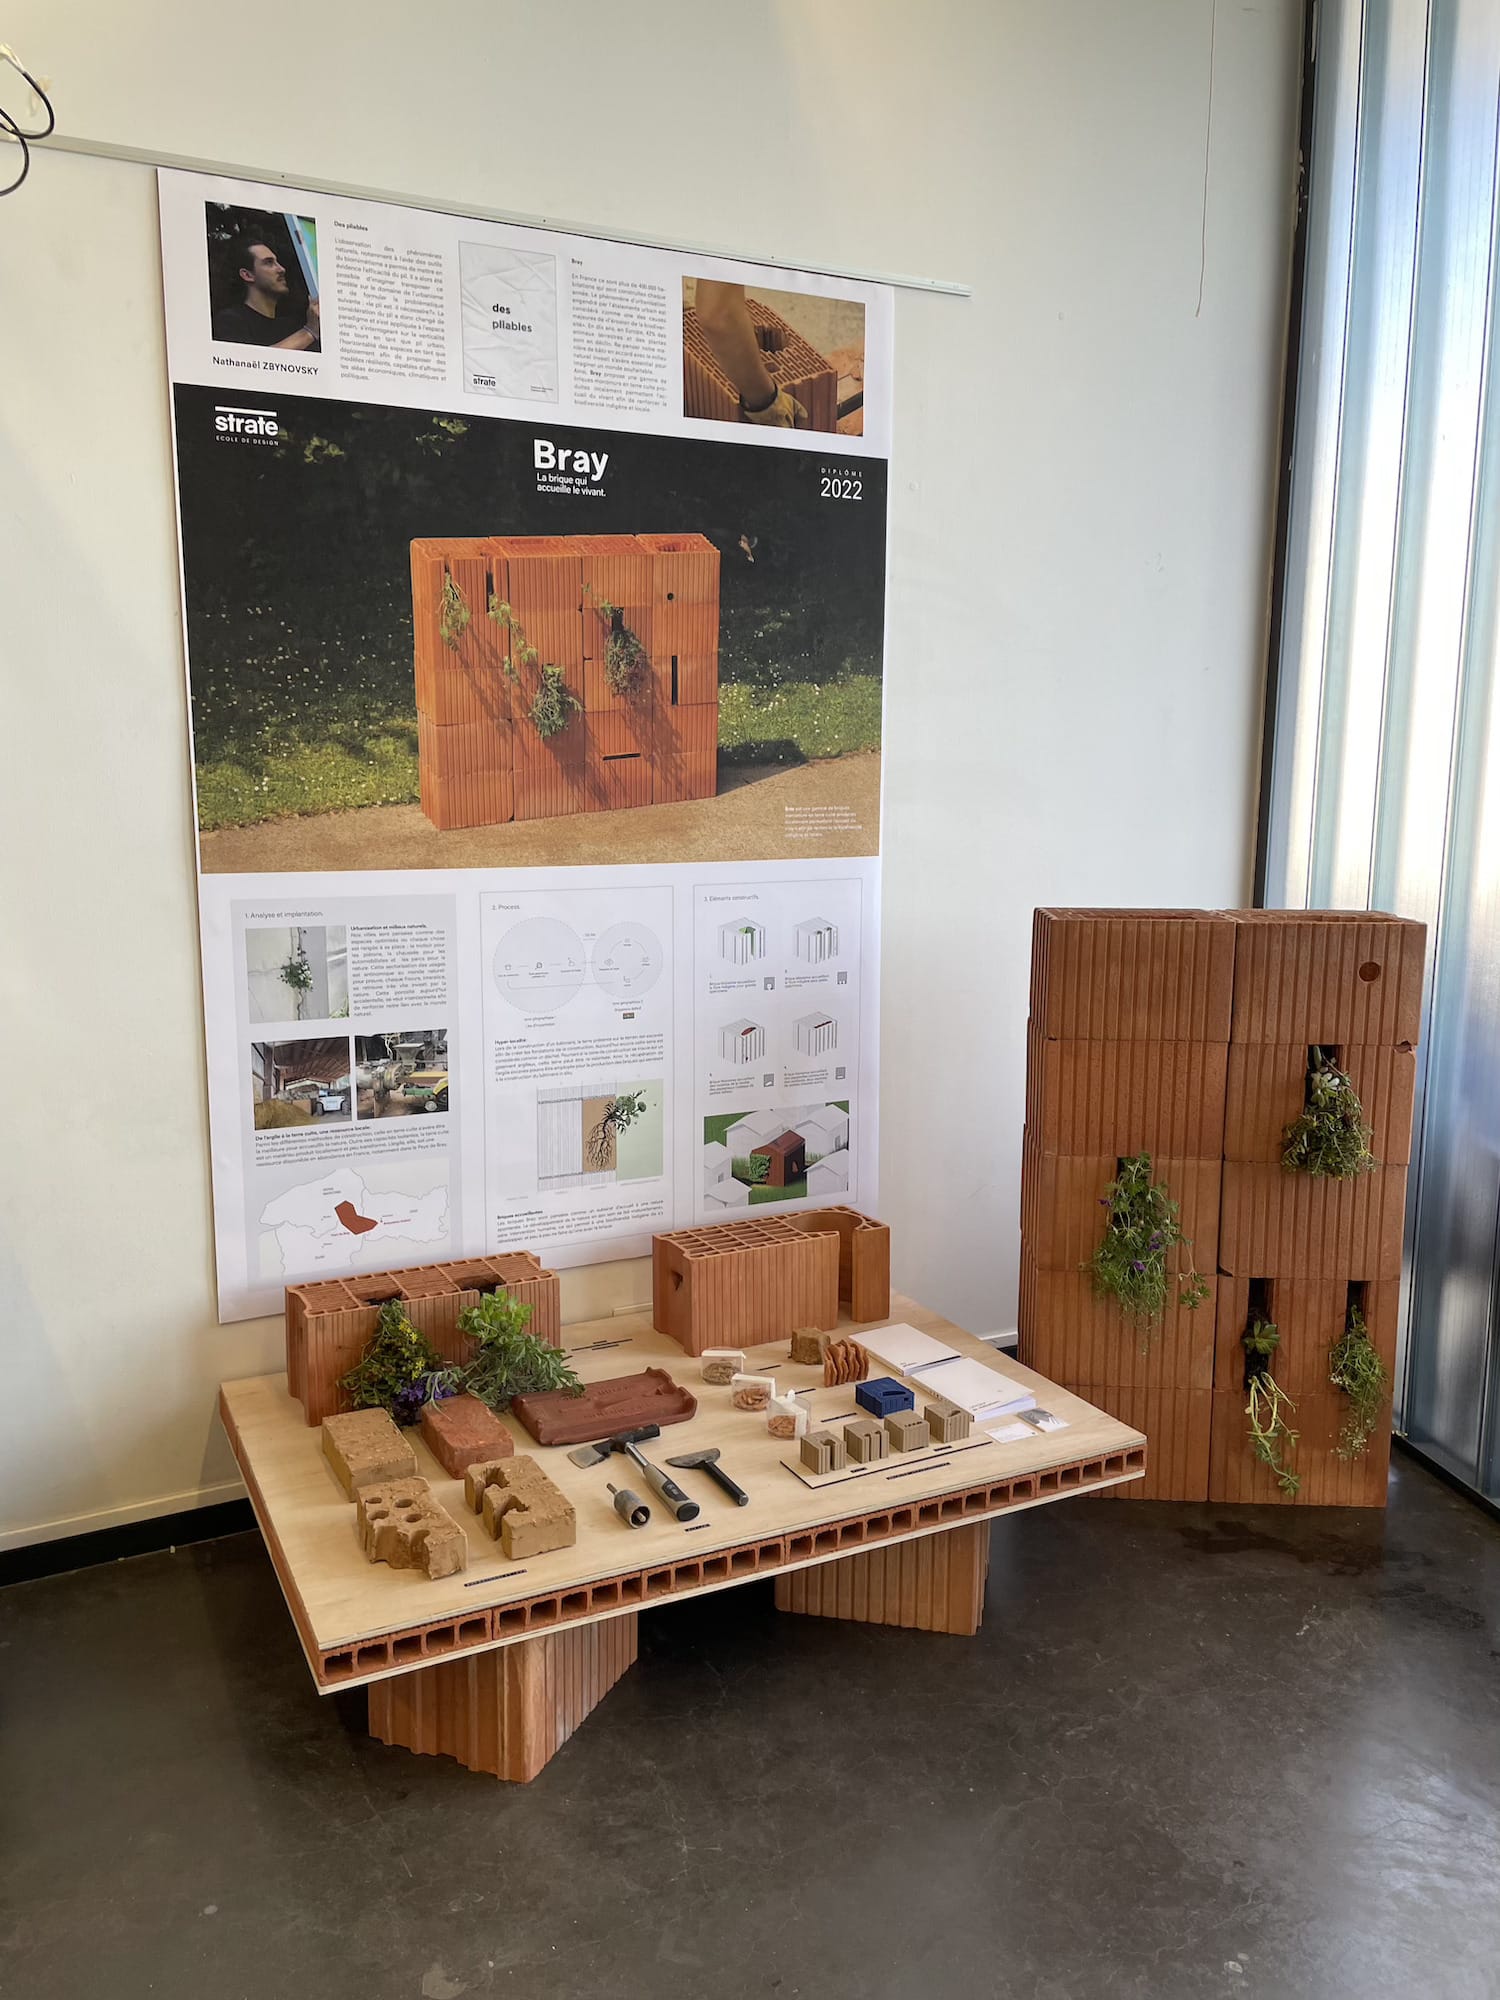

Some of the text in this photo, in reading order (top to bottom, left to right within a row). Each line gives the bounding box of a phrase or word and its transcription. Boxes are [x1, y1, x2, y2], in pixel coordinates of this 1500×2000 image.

[346, 223, 368, 233] pliables
[571, 258, 583, 266] Bray
[492, 304, 511, 314] des
[492, 320, 532, 332] pliables
[212, 356, 318, 376] Nathanaël ZBYNOVSKY
[472, 378, 496, 386] strate
[214, 414, 278, 436] strate
[534, 438, 609, 481] Bray
[536, 472, 588, 486] La brique qui
[820, 468, 862, 478] DIPLÔME
[536, 484, 606, 496] accueille le vivant.
[820, 478, 862, 500] 2022
